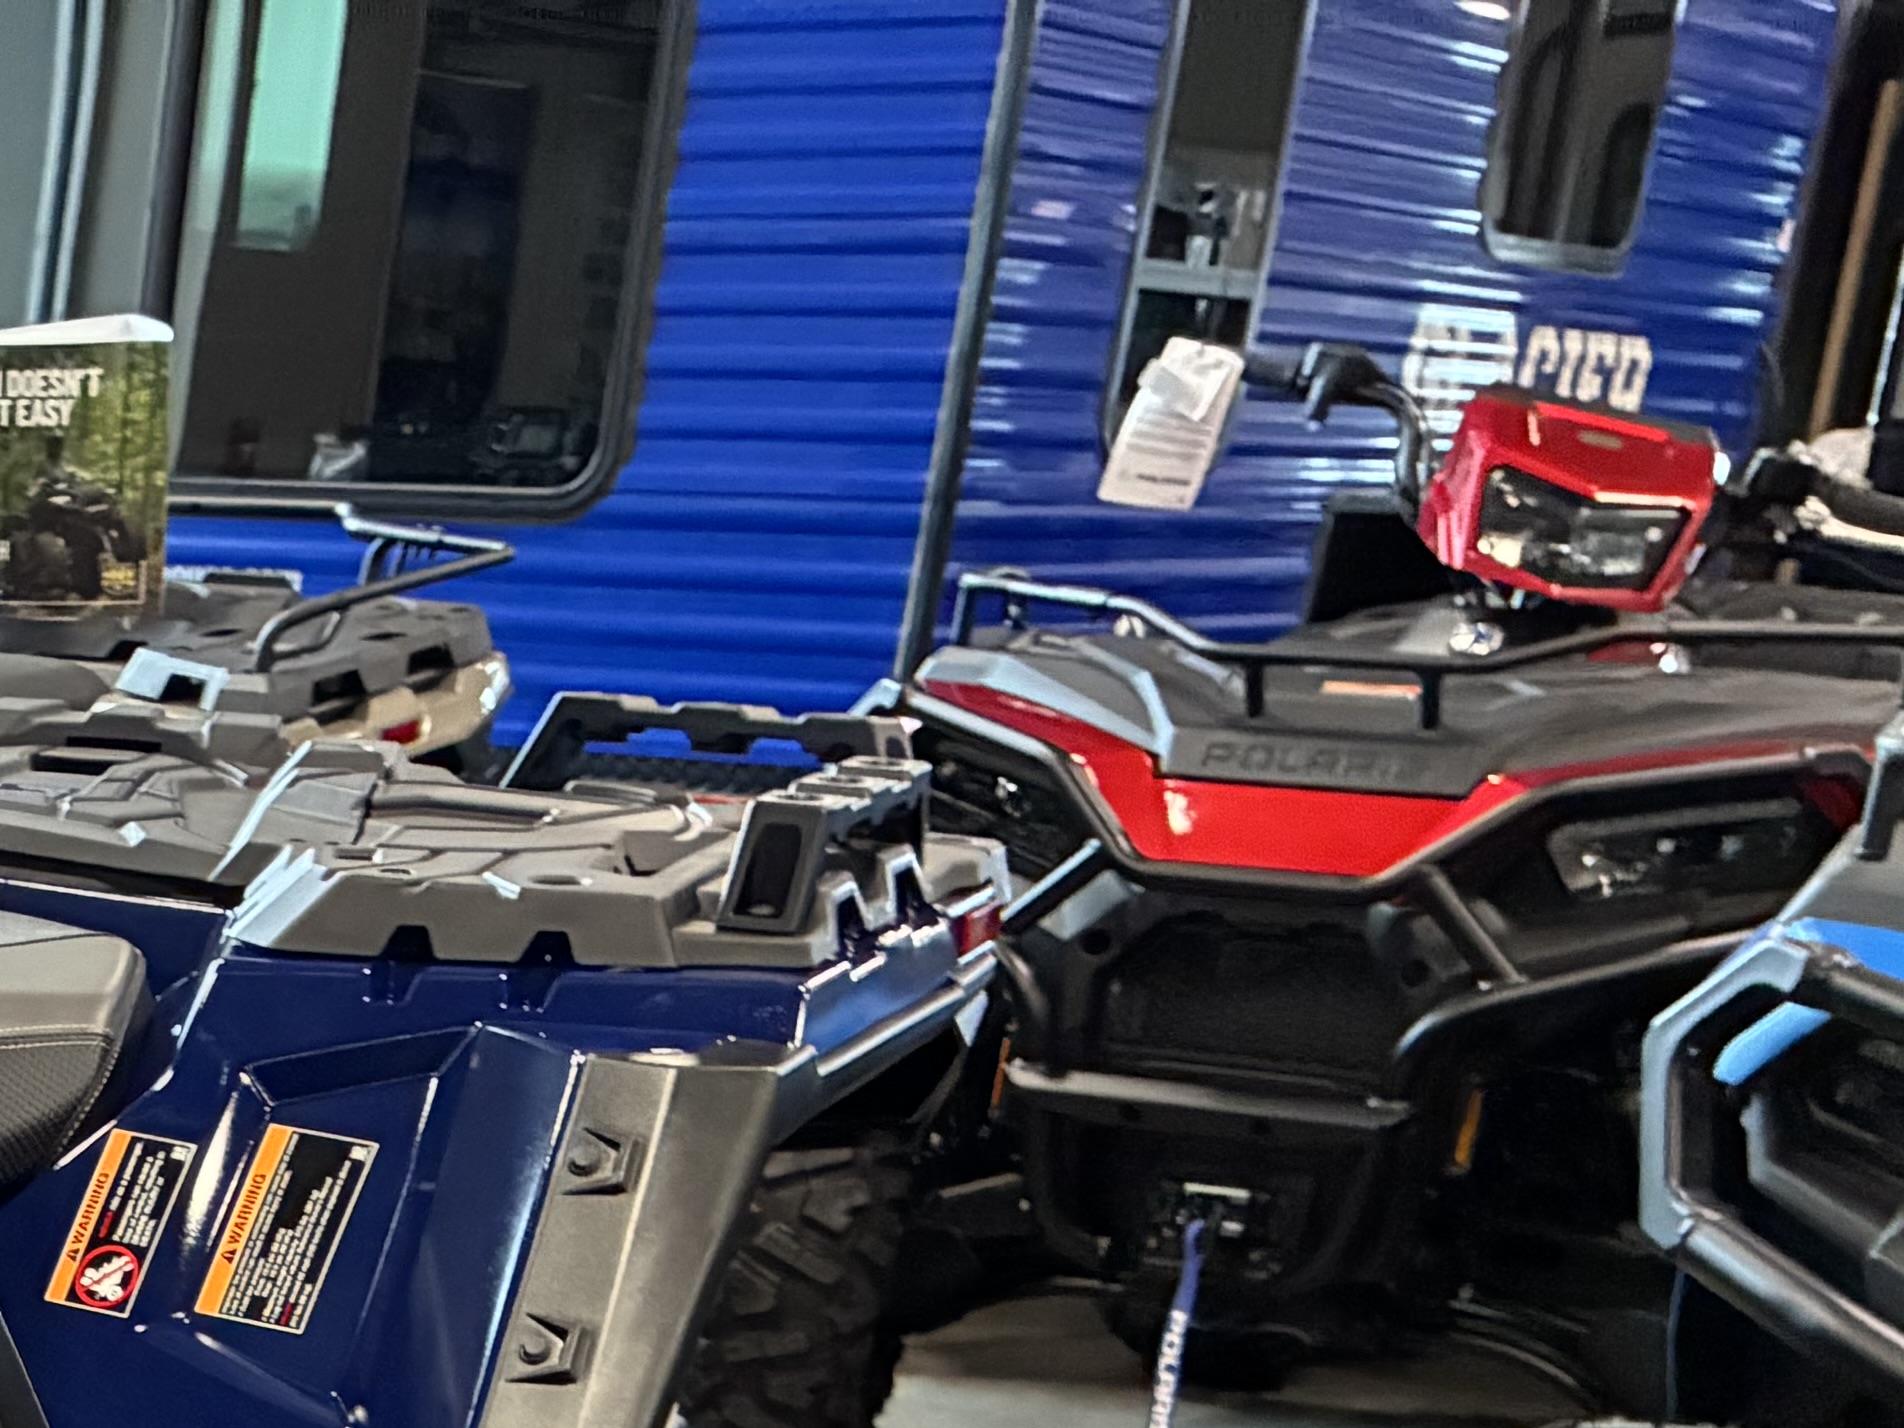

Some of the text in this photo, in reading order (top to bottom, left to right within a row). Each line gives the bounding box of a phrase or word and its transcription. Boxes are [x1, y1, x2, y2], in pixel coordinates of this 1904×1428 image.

[6, 367, 104, 398] DOESN'T
[15, 399, 75, 427] EASY
[71, 1172, 110, 1244] WARNING
[227, 1173, 267, 1244] WARNING
